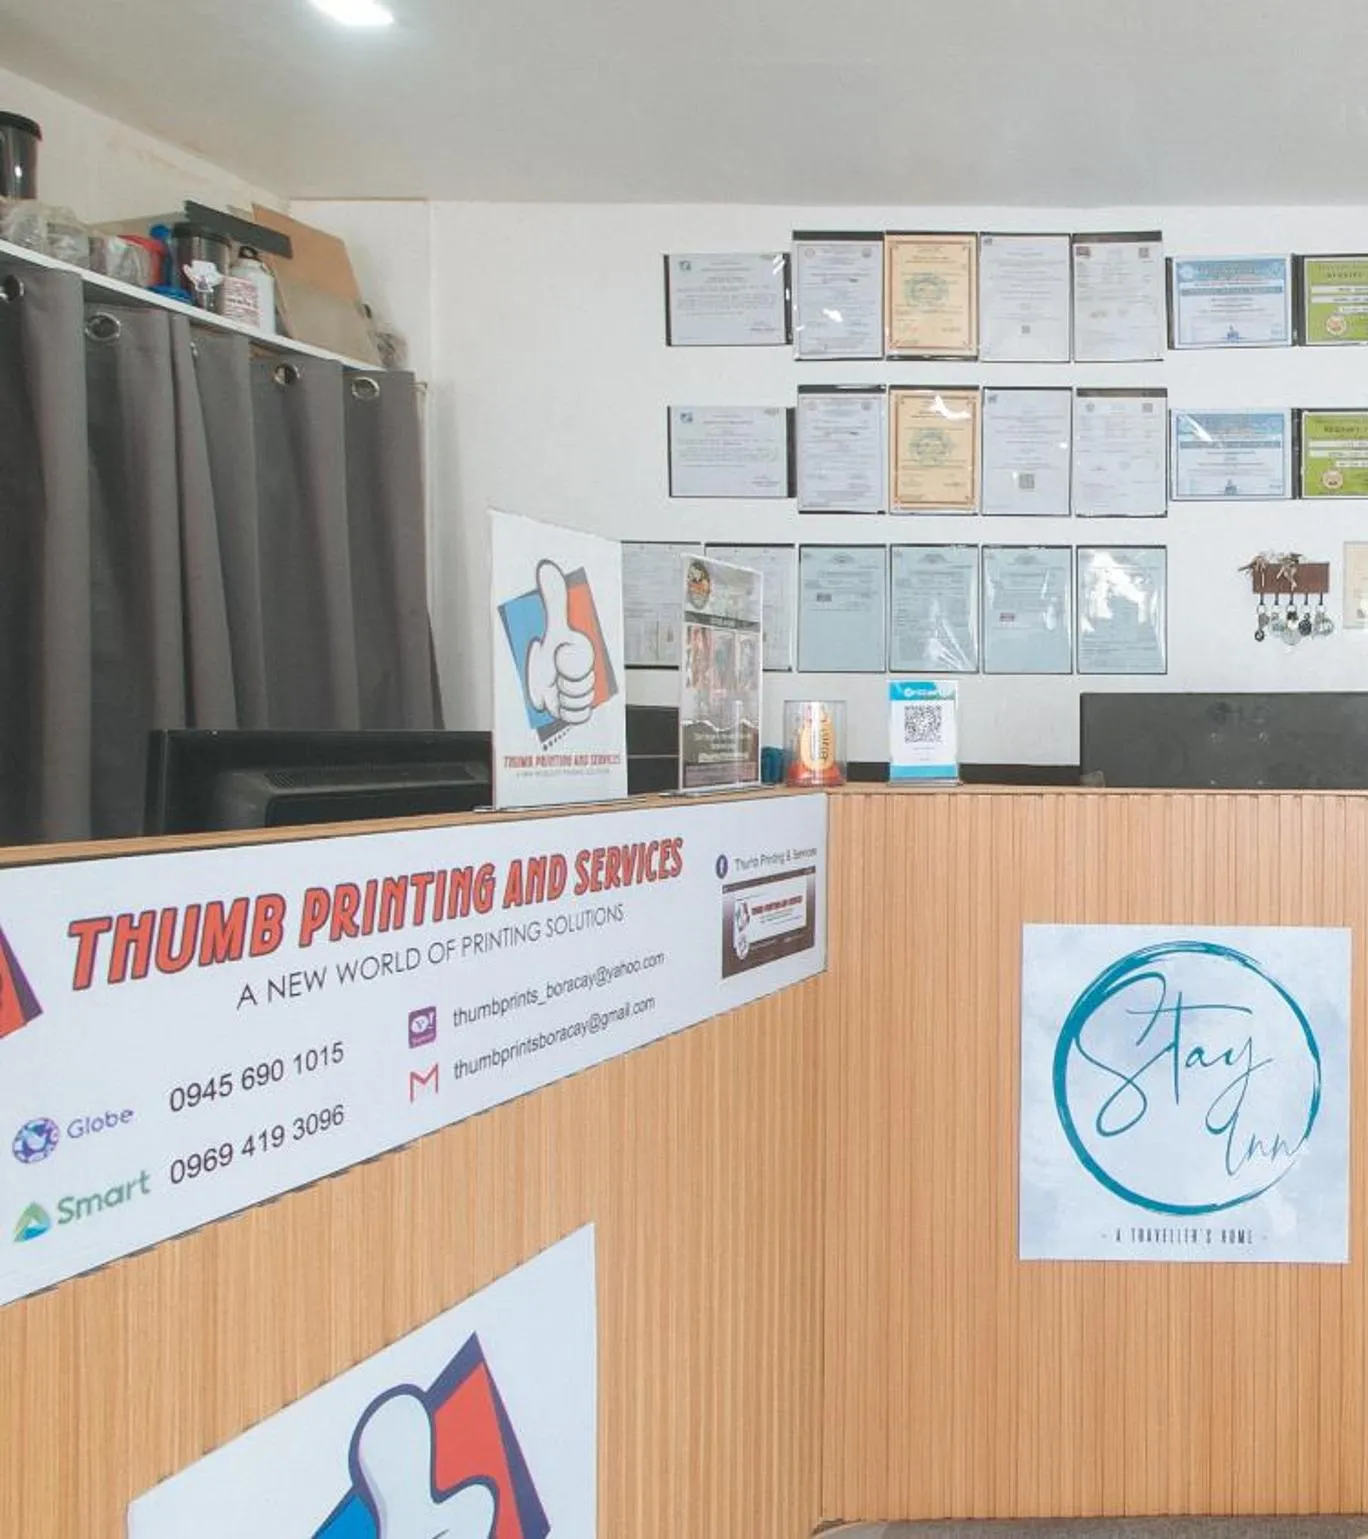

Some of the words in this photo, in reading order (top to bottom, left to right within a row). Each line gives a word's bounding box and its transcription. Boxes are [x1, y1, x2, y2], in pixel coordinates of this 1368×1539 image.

[67, 893, 287, 992] THUMB
[298, 862, 497, 949] PRINTING
[502, 853, 569, 910] AND
[574, 836, 685, 897] SERVICES
[236, 984, 259, 1010] A
[267, 966, 328, 1004] NEW
[336, 948, 421, 985] WORLD
[428, 939, 456, 965] OF
[461, 921, 542, 958] PRINTING
[546, 903, 625, 938] SOLUTIONS
[453, 951, 665, 1027] thumbprints_boracay@yahoo.com
[169, 1072, 234, 1113] 0945
[241, 1058, 285, 1091] 690
[292, 1041, 345, 1076] 1015
[454, 995, 656, 1080] thumbprintsboracay@gmail.com
[1075, 971, 1274, 1137] Stay
[66, 1107, 135, 1140] Globe
[169, 1142, 234, 1185] 0969
[240, 1124, 286, 1158] 419
[292, 1103, 345, 1142] 3096
[1222, 1107, 1309, 1177] Inn
[56, 1169, 152, 1226] Smart
